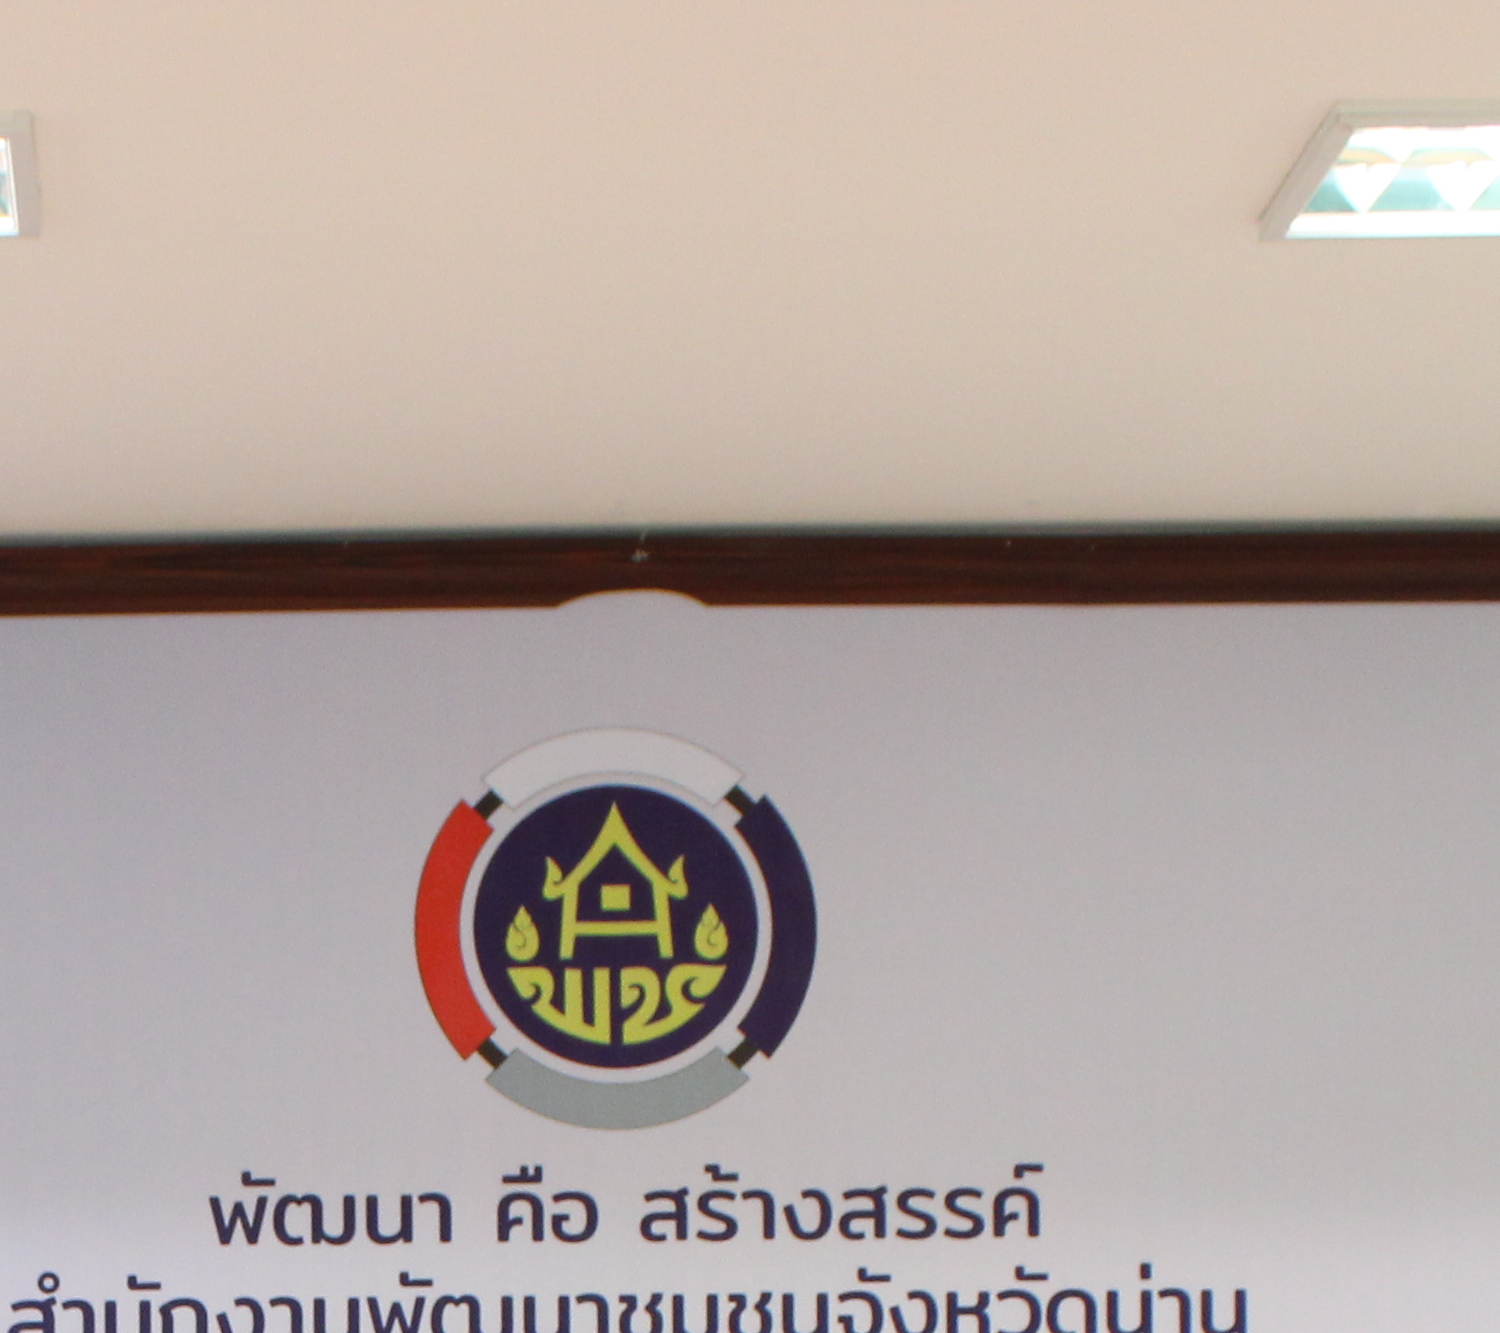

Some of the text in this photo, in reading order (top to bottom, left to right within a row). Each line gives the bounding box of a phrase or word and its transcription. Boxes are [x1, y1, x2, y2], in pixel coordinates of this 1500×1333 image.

[207, 1162, 1045, 1247] พัฒนา คือ สร้างสรรค์
